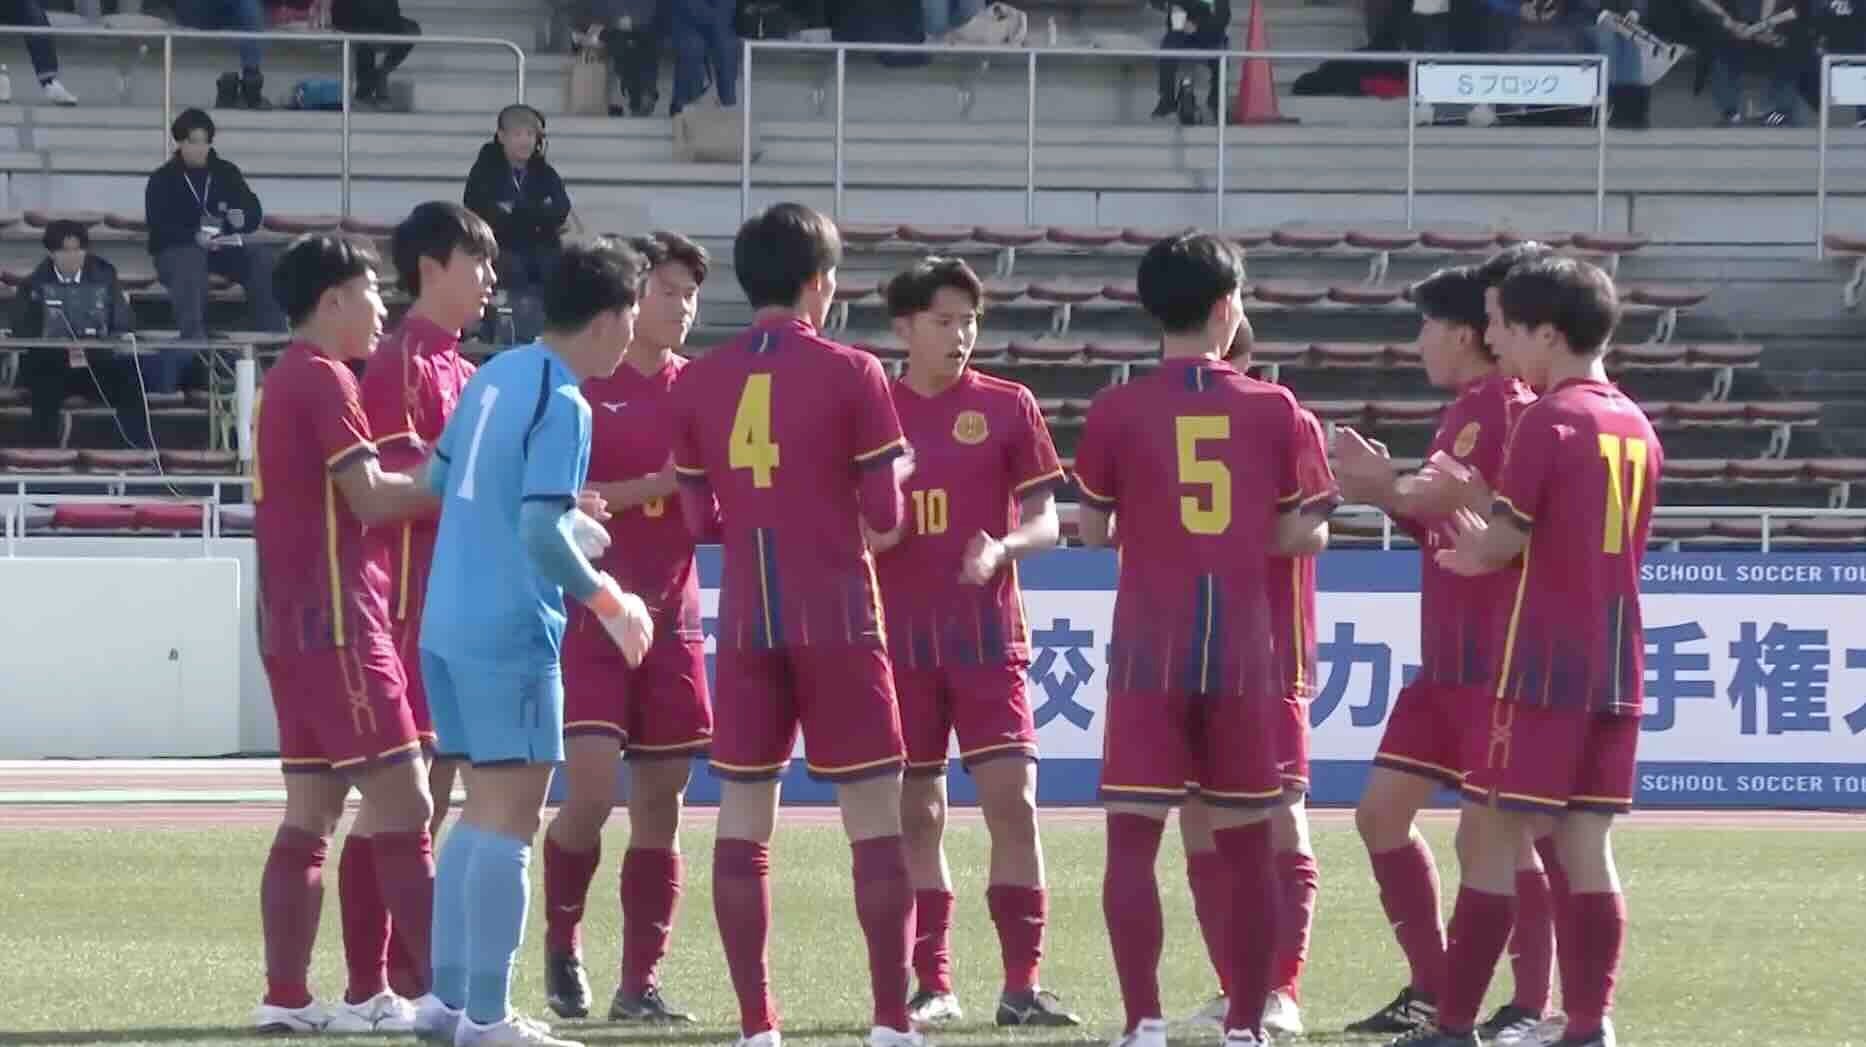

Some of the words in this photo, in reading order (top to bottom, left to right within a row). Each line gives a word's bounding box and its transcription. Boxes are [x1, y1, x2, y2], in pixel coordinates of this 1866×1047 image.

[457, 384, 498, 501] 1
[728, 373, 779, 488] 4
[912, 488, 948, 535] 10
[1175, 415, 1231, 535] 5
[1641, 565, 1727, 582] SCHOOL
[1736, 565, 1822, 582] SOCCER
[1641, 775, 1728, 792] SCHOOL
[1736, 775, 1823, 793] SOCCER
